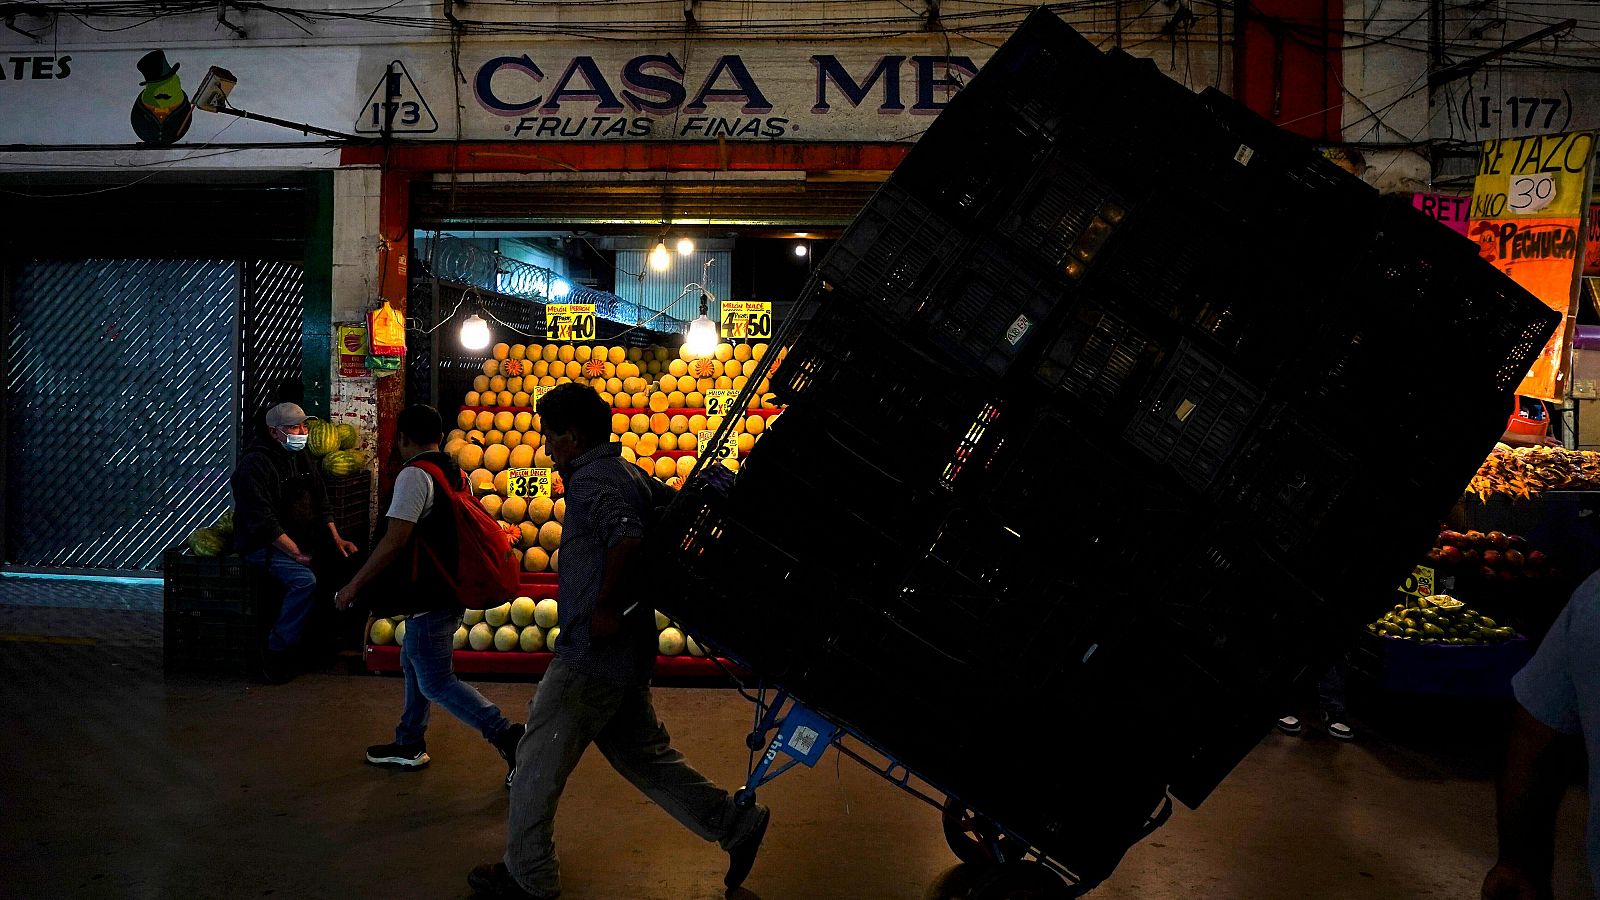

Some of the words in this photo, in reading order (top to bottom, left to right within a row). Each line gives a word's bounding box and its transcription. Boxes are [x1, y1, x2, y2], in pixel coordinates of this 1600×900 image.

[474, 53, 773, 115] CASA
[372, 101, 420, 126] 173
[514, 117, 655, 137] FRUTAS
[680, 117, 789, 137] FINAS
[1479, 132, 1594, 175] RETAZO
[1510, 178, 1553, 208] 30
[1422, 196, 1471, 223] RET
[1500, 222, 1577, 260] PECHUGA
[547, 315, 559, 339] 4
[572, 314, 594, 339] 40
[722, 312, 735, 337] 4
[748, 313, 771, 337] 50
[708, 398, 718, 415] 2
[515, 476, 539, 497] 35
